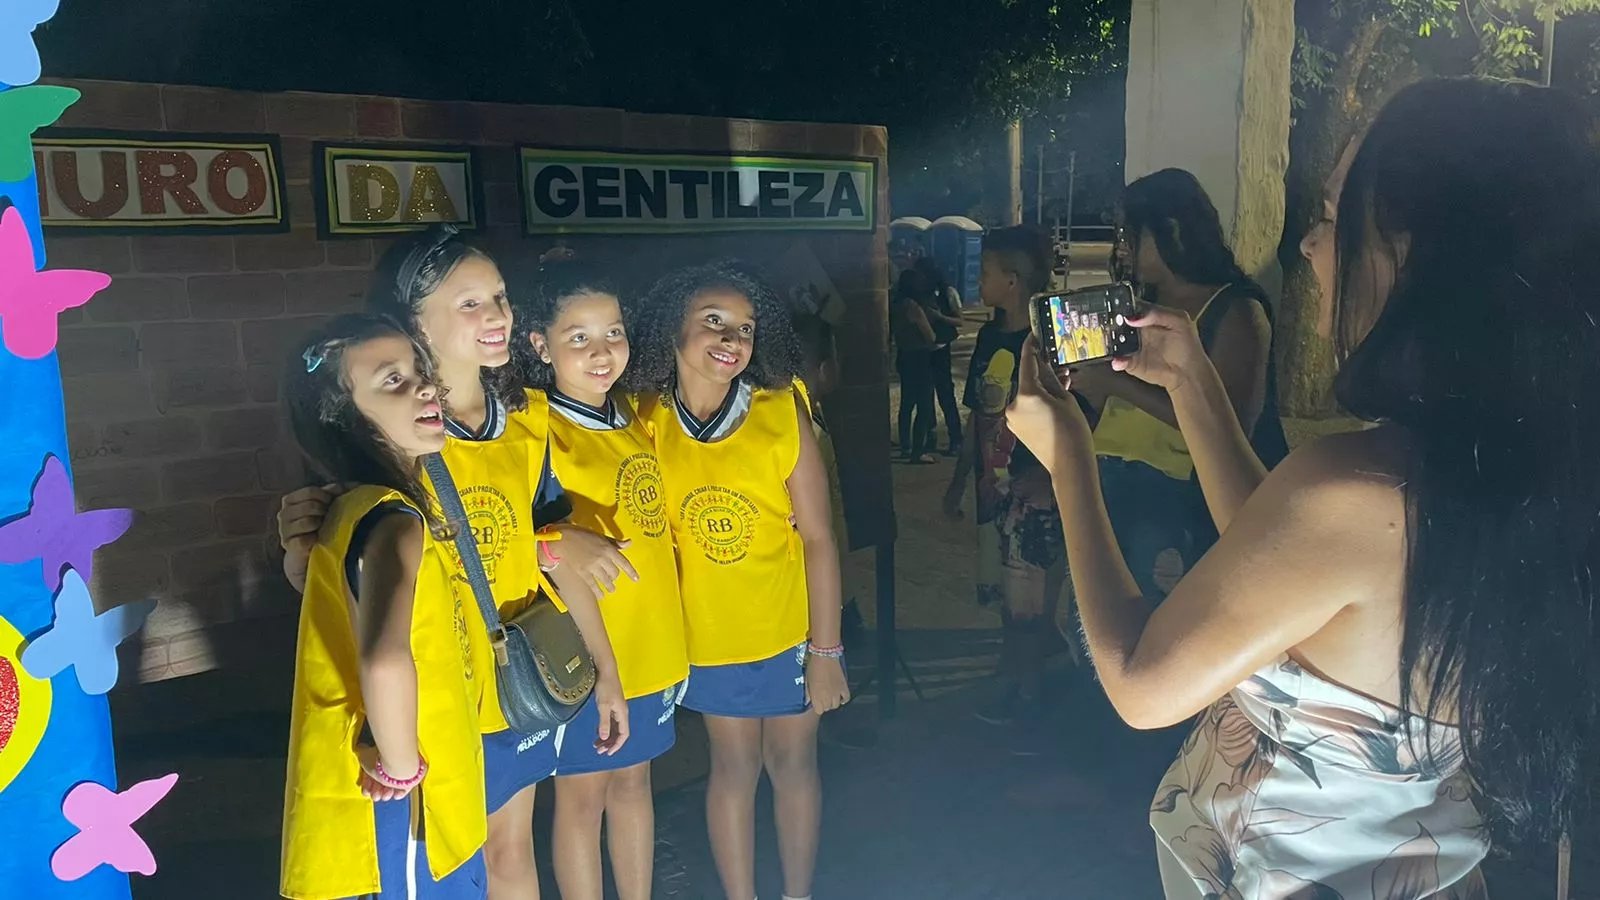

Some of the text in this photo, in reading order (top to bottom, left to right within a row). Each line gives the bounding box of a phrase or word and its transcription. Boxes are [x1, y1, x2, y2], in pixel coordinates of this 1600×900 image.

[346, 163, 459, 221] DA
[533, 164, 864, 219] GENTILEZA
[638, 485, 658, 505] RB
[707, 517, 733, 533] RB
